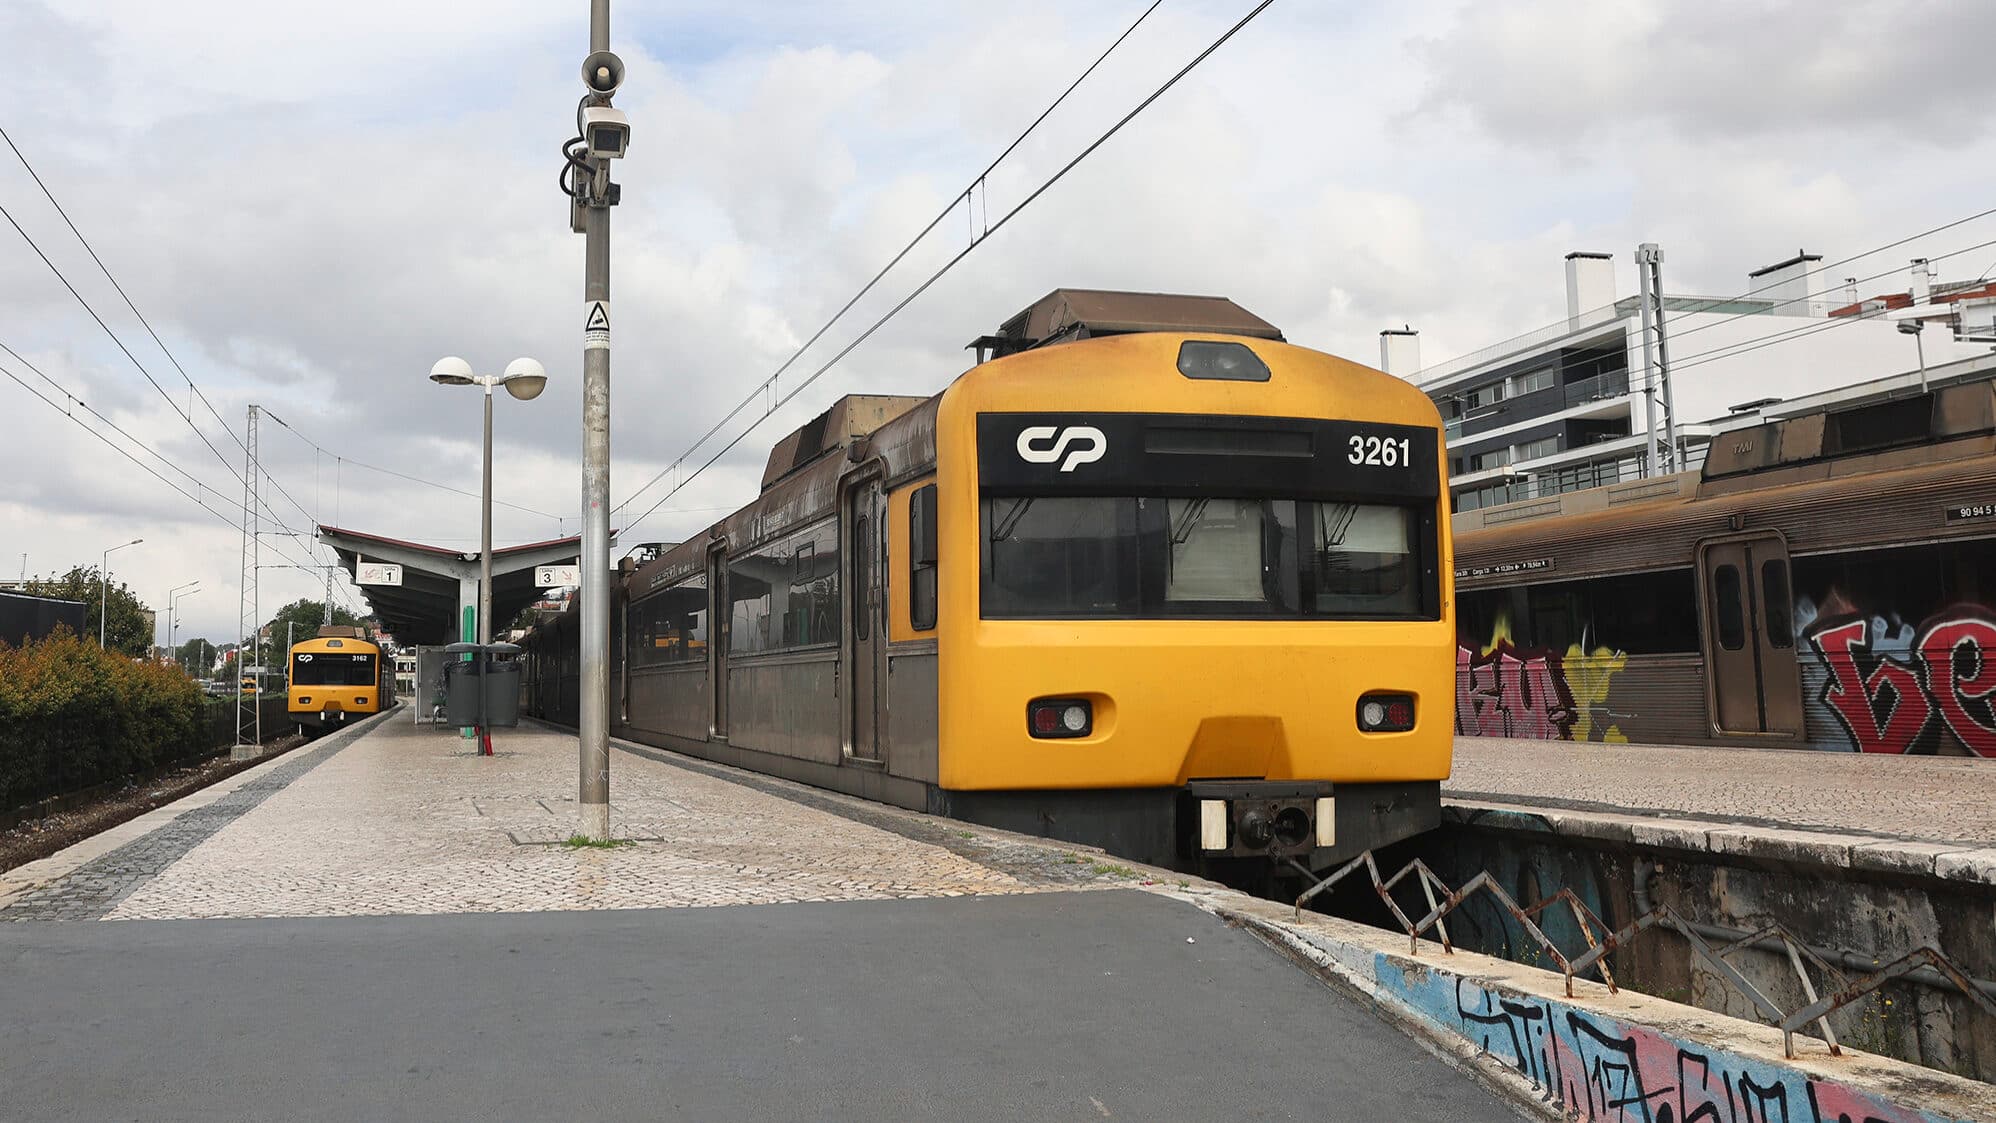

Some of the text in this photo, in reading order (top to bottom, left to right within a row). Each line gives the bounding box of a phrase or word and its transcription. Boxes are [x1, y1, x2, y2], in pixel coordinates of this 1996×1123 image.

[1347, 435, 1410, 467] 3261
[1960, 505, 1992, 518] 90 94 5
[386, 571, 392, 581] 1
[543, 573, 551, 583] 3
